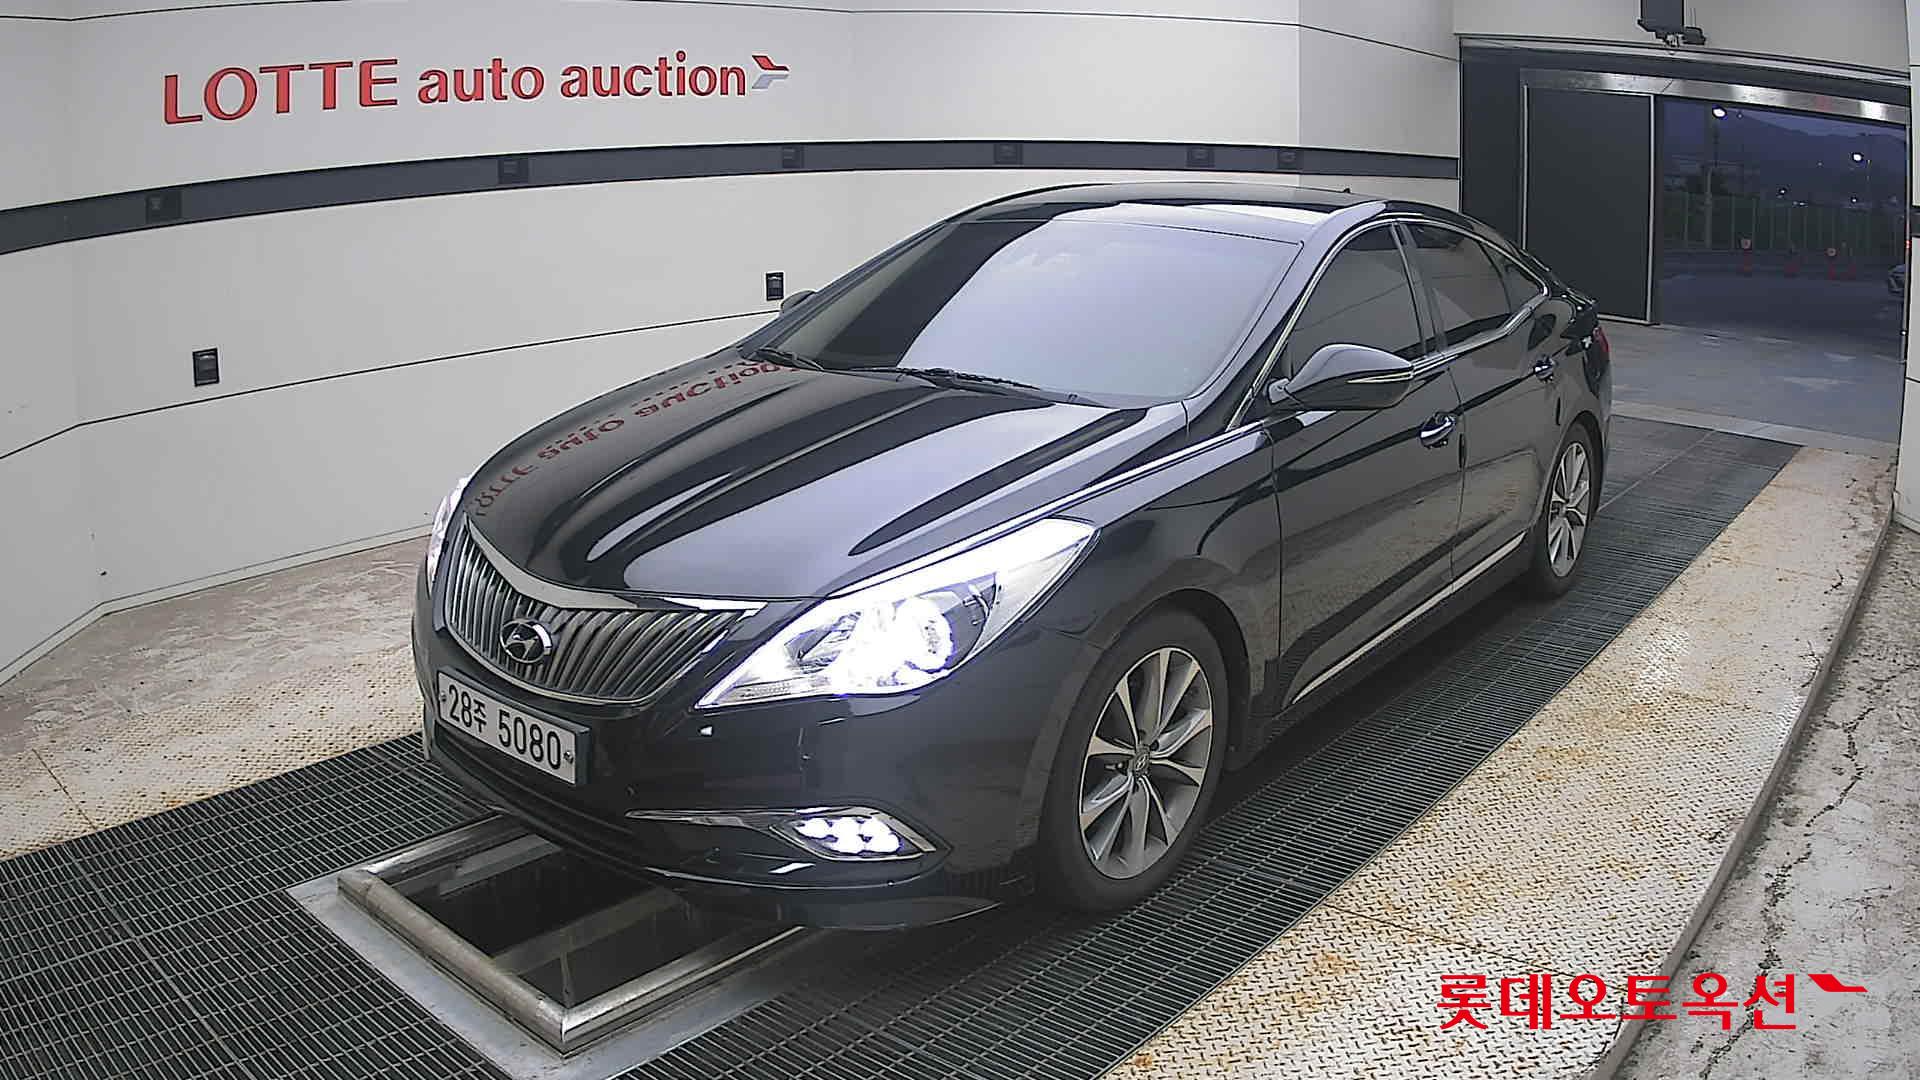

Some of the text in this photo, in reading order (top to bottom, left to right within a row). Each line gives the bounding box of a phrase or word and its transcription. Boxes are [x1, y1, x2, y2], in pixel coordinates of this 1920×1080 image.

[163, 49, 747, 125] LOTTE auto auction
[449, 684, 562, 770] 28주 5080
